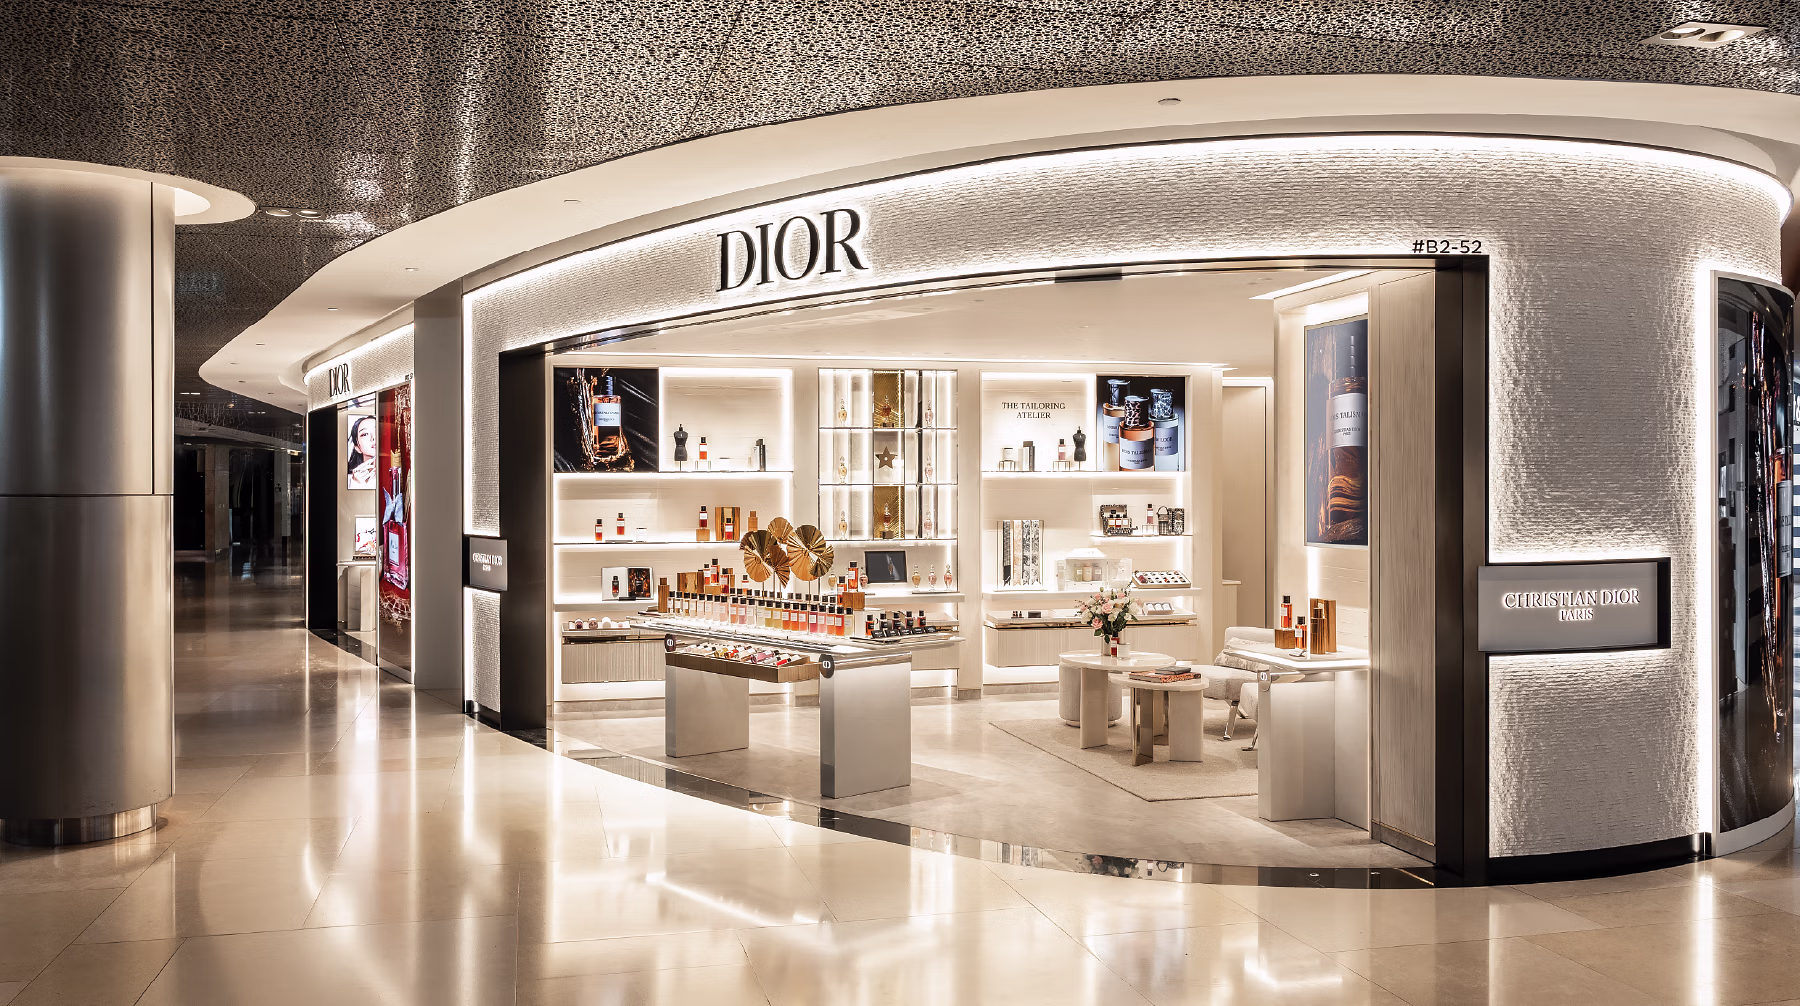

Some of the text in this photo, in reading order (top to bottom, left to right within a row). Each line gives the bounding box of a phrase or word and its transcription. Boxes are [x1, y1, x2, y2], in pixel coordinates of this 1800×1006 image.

[716, 208, 869, 292] DIOR
[1412, 239, 1482, 254] #B2-52
[329, 362, 350, 397] DIOR
[1001, 402, 1066, 410] THE TAILORING
[1016, 411, 1051, 419] ATELIER
[1503, 588, 1641, 609] CHRISTIAN DIOR
[1558, 608, 1594, 621] PARIS
